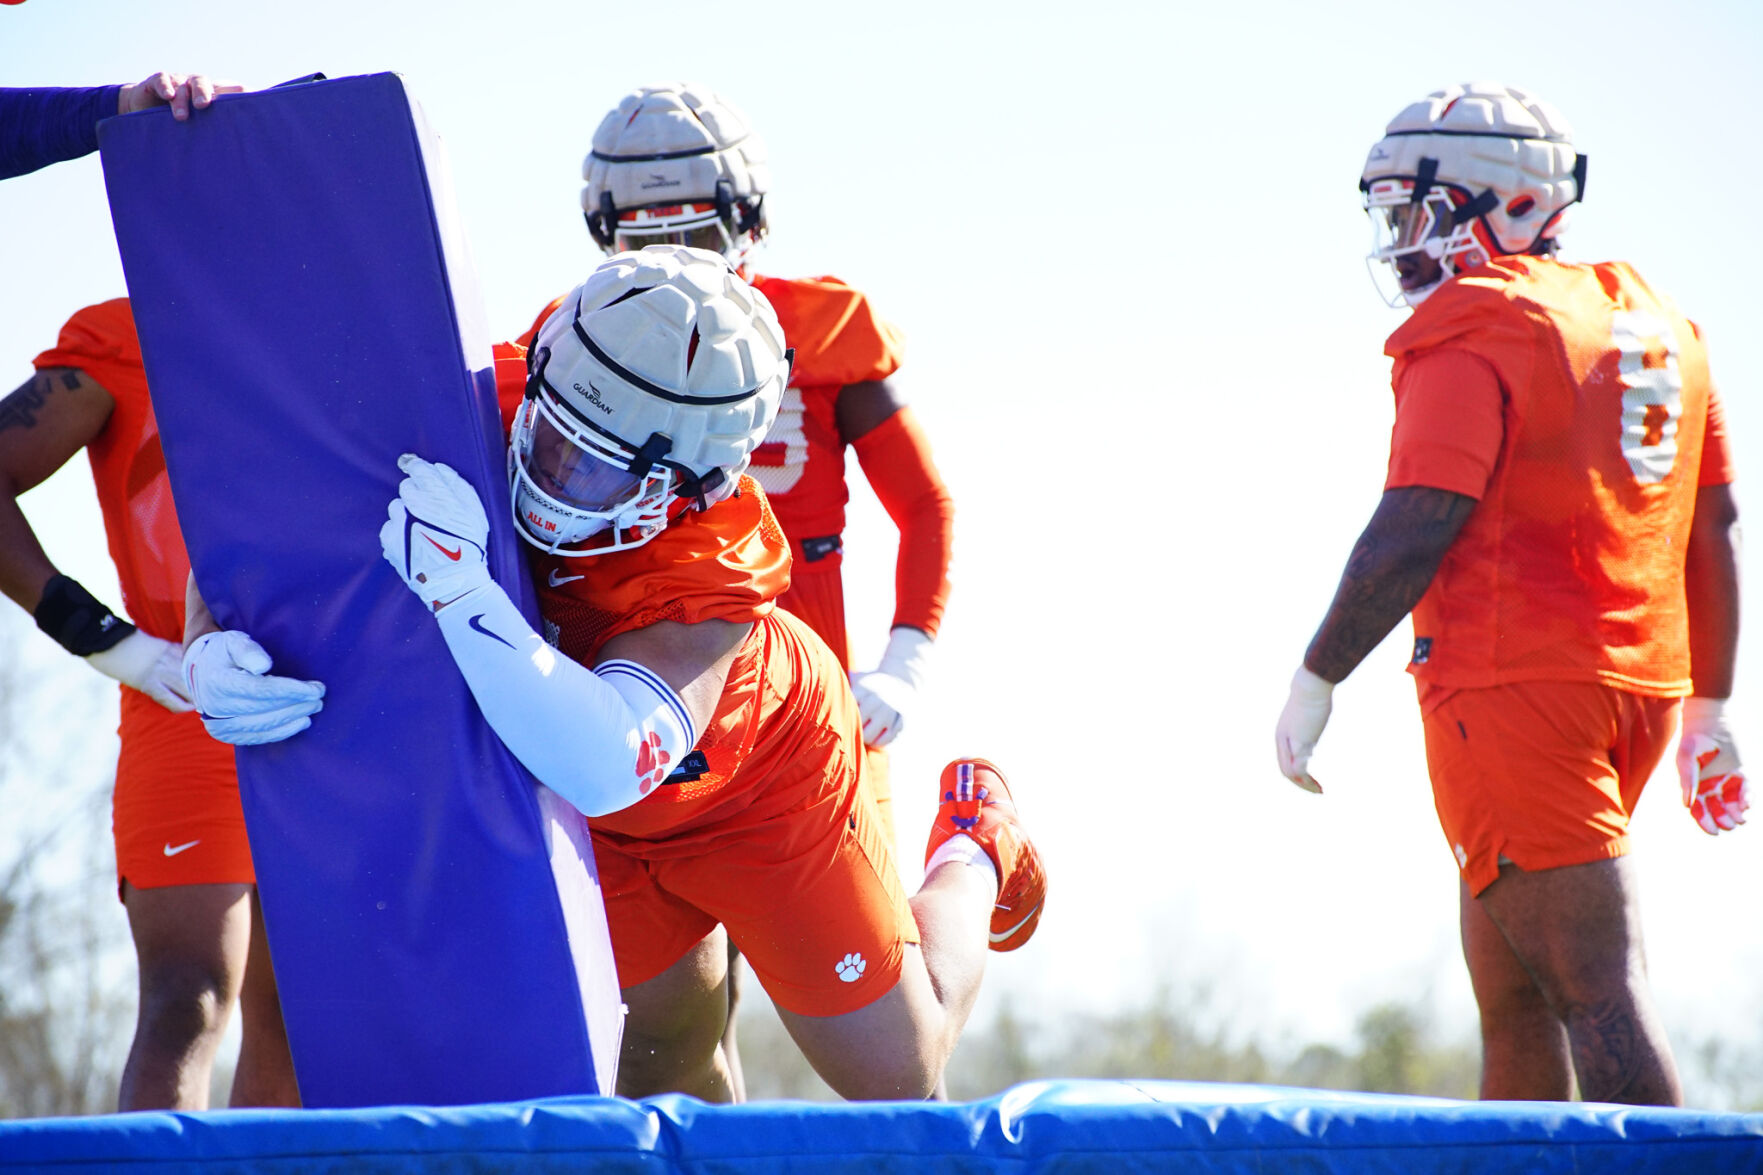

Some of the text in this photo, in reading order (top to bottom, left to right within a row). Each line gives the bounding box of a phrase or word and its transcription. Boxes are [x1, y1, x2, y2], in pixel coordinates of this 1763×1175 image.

[573, 382, 613, 415] GUARDIAN
[527, 511, 557, 532] ALL IN
